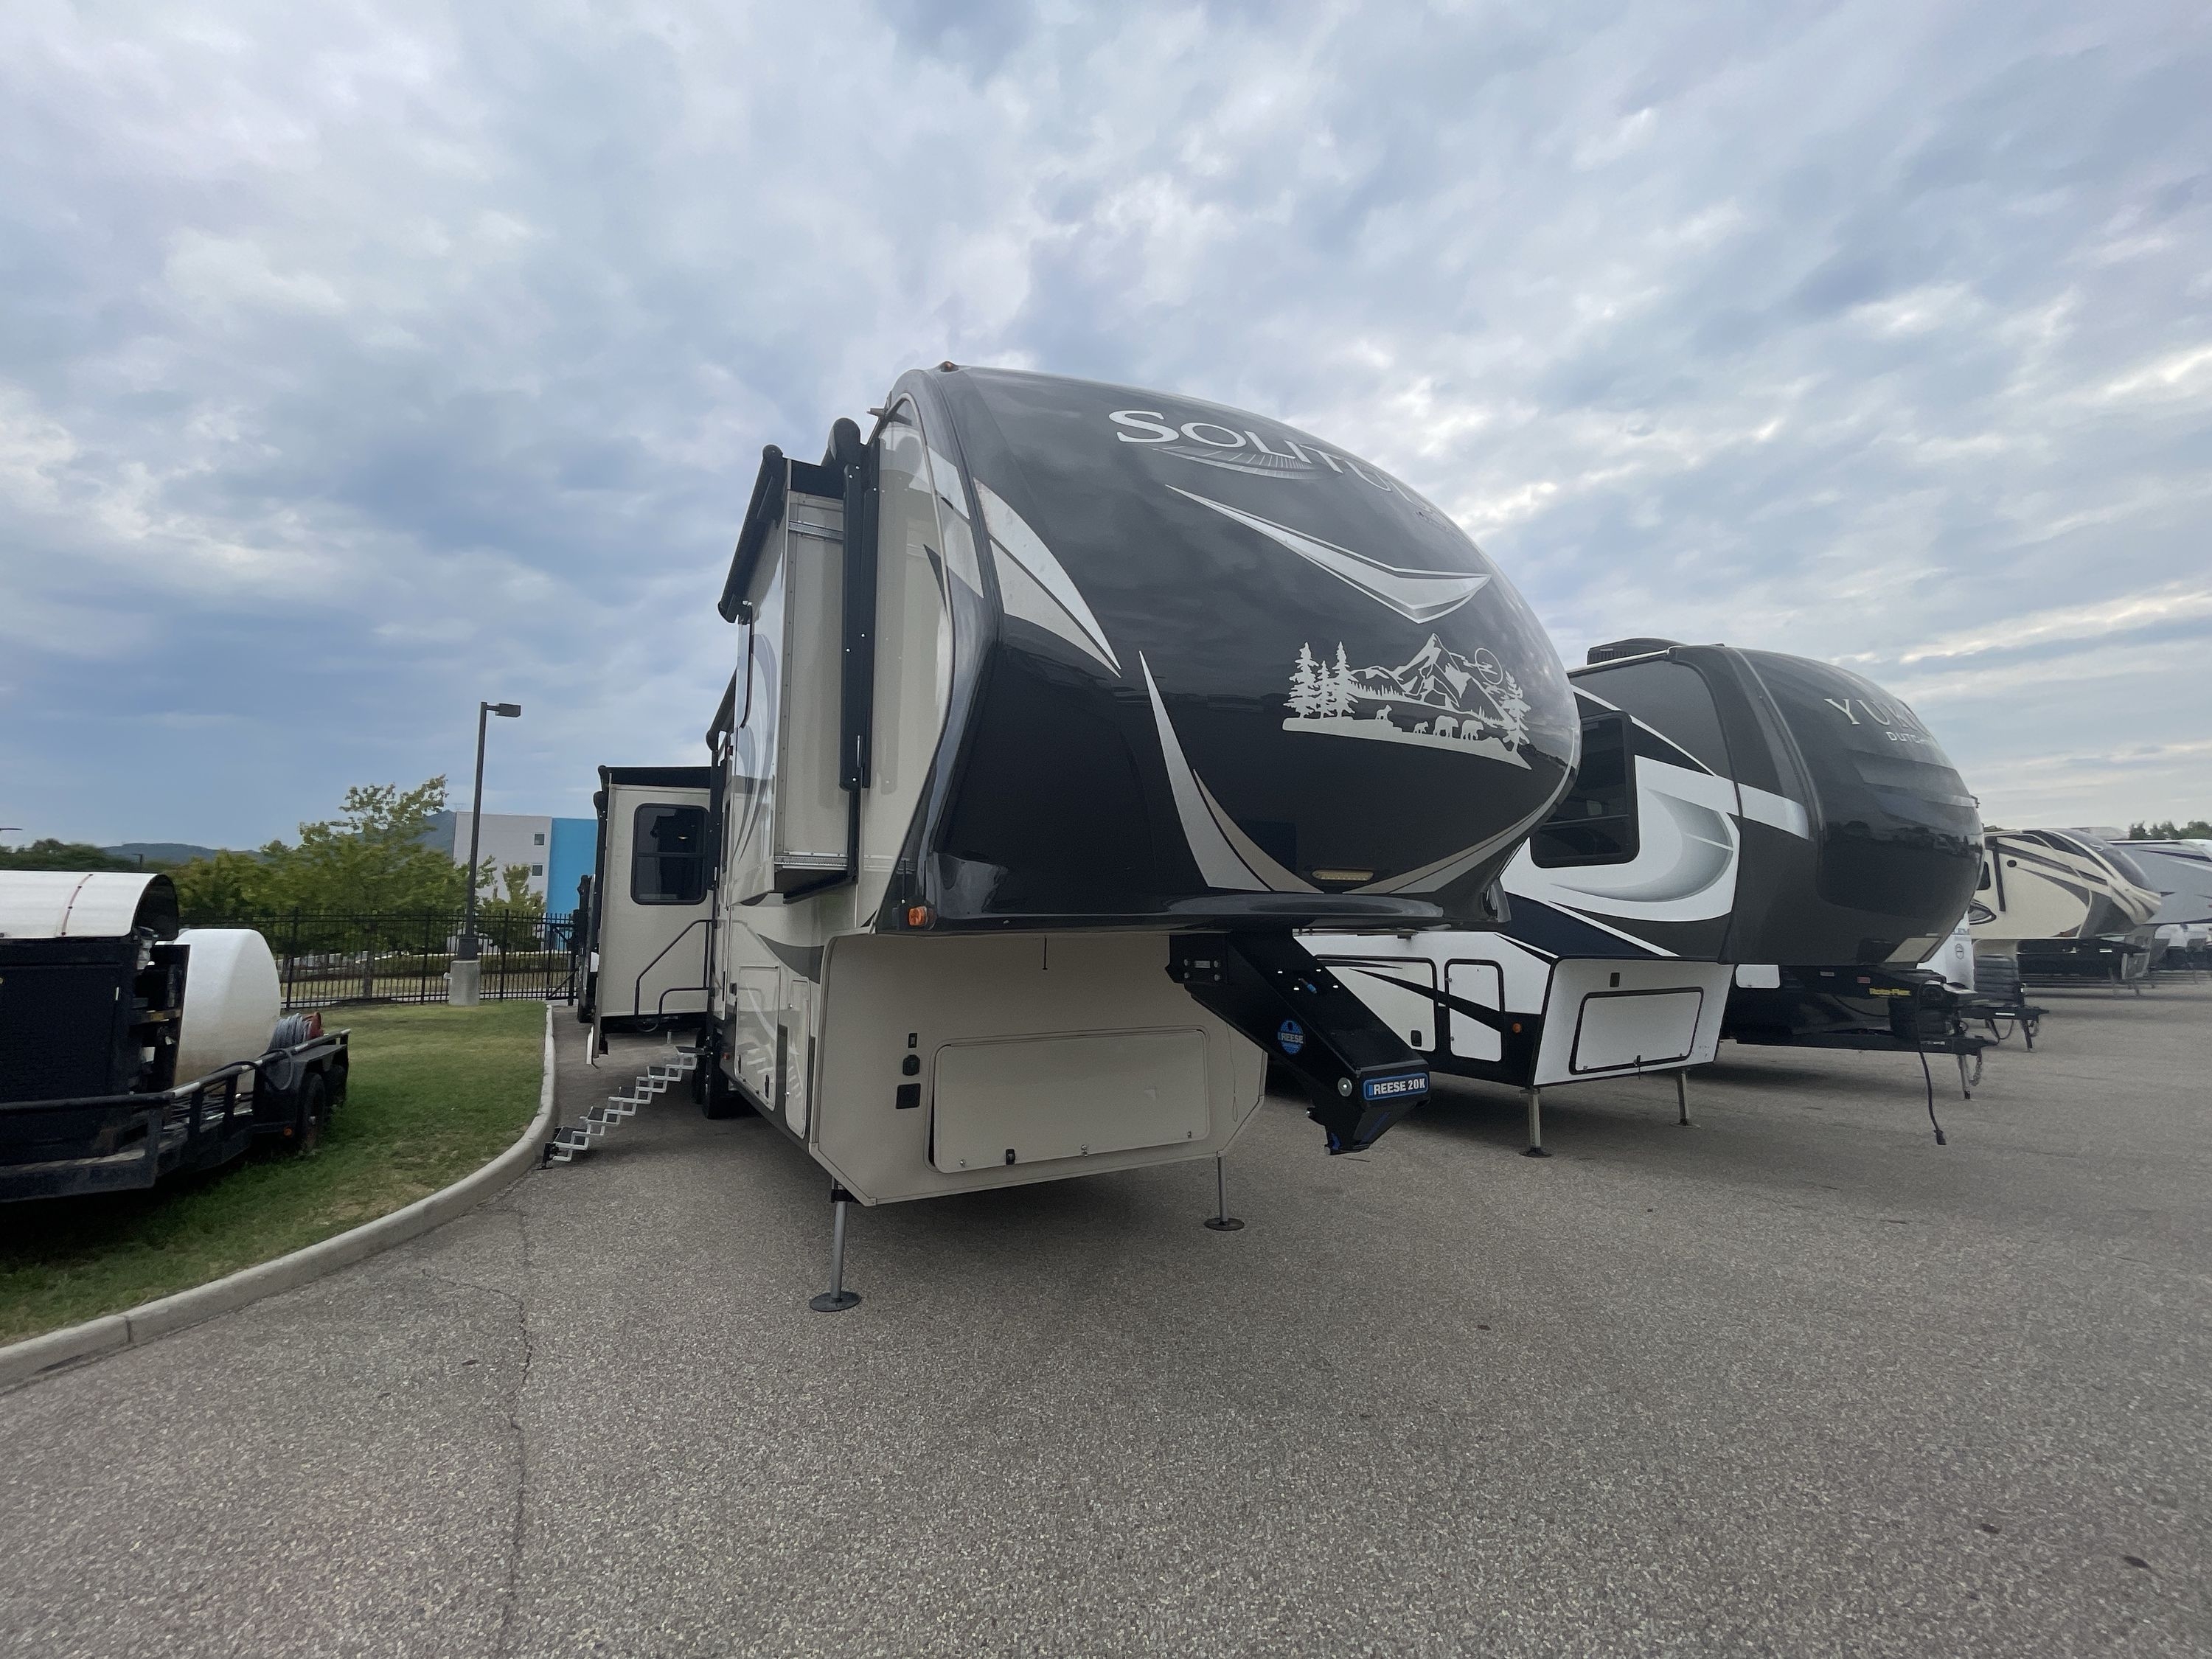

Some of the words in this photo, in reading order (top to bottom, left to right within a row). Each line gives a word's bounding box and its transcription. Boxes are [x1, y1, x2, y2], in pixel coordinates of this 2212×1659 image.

[1281, 1032, 1304, 1044] REESE
[1374, 1081, 1406, 1096] REESE
[1408, 1078, 1425, 1090] 20K
